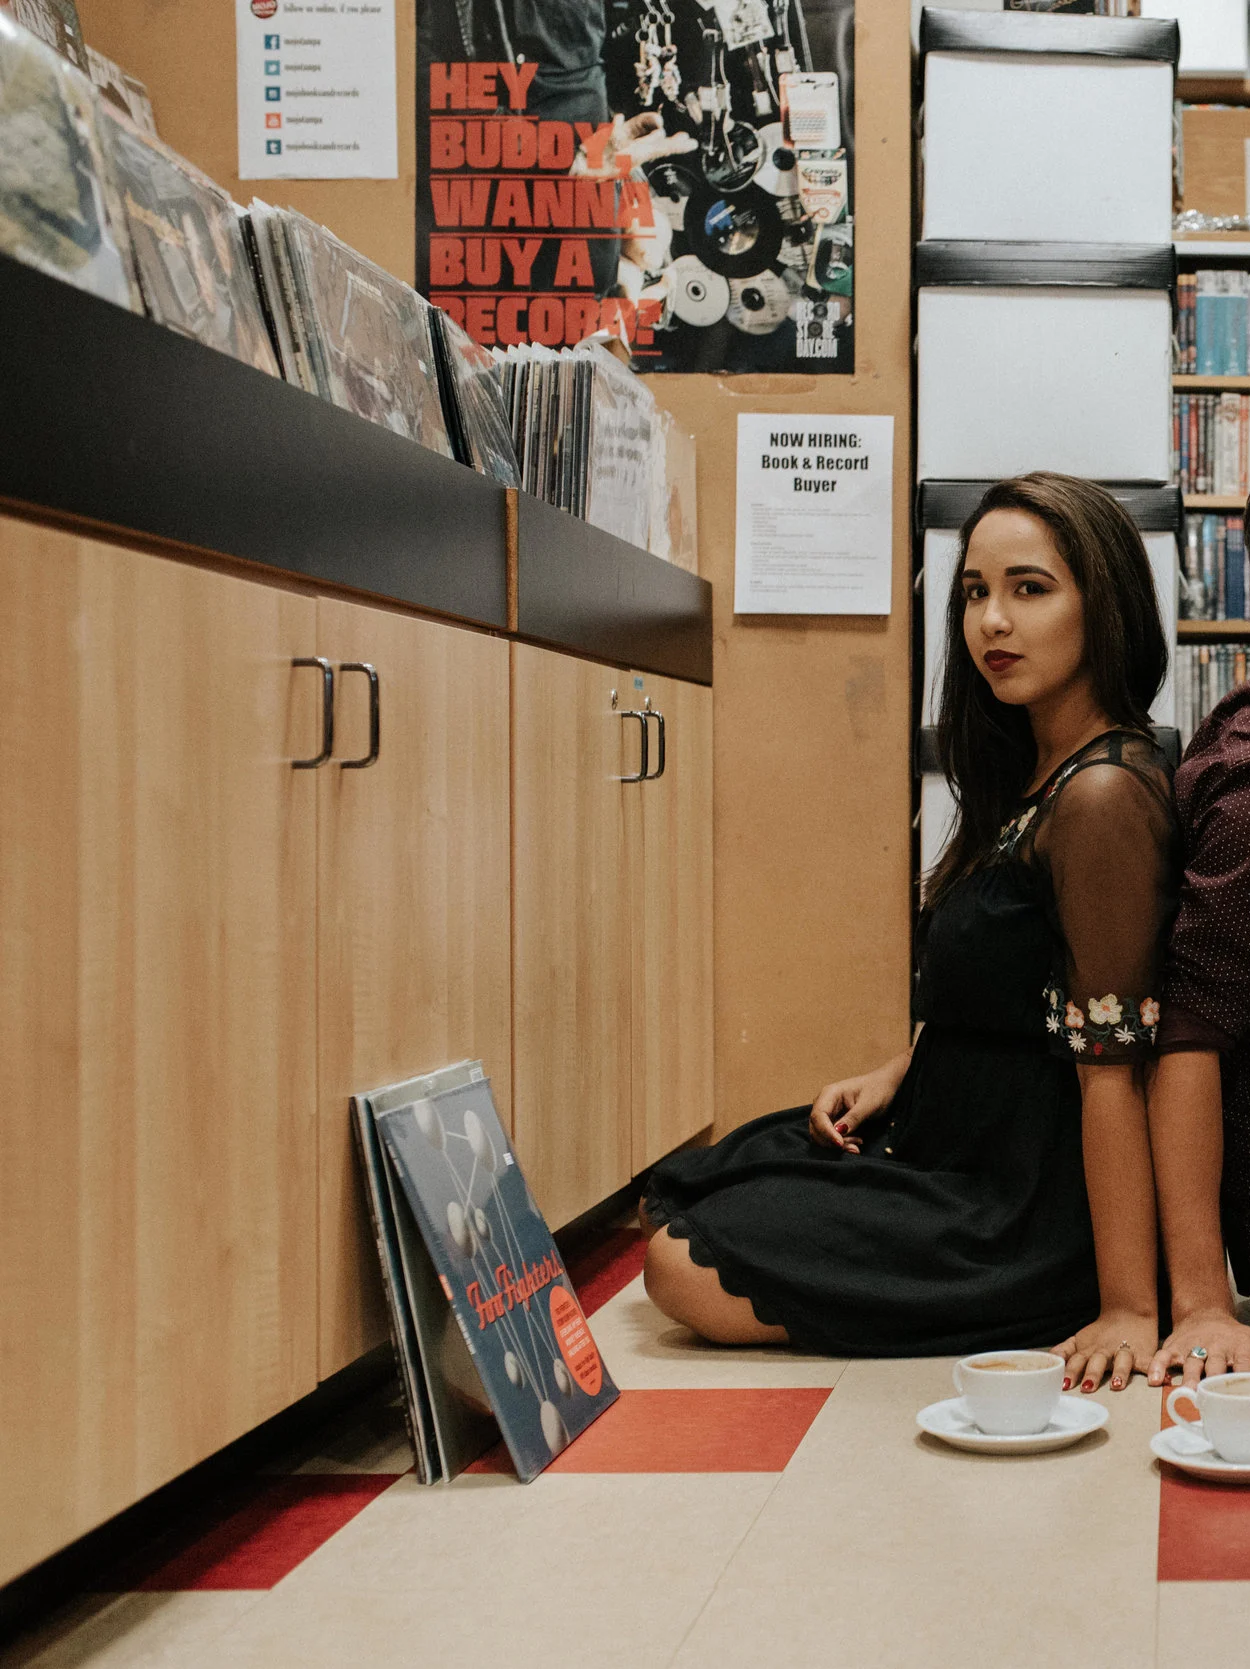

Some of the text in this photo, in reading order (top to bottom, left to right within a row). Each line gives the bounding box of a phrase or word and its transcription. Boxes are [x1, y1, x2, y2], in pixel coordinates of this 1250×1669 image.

[430, 62, 539, 110] HEY
[430, 121, 632, 178] BUDDY,
[430, 180, 655, 227] WANNA
[429, 238, 595, 287] BUY A
[762, 454, 869, 470] Book & Record
[770, 432, 862, 448] NOW HIRING:
[793, 477, 837, 493] Buyer
[466, 1281, 505, 1331] Foo
[495, 1249, 564, 1312] Fighters
